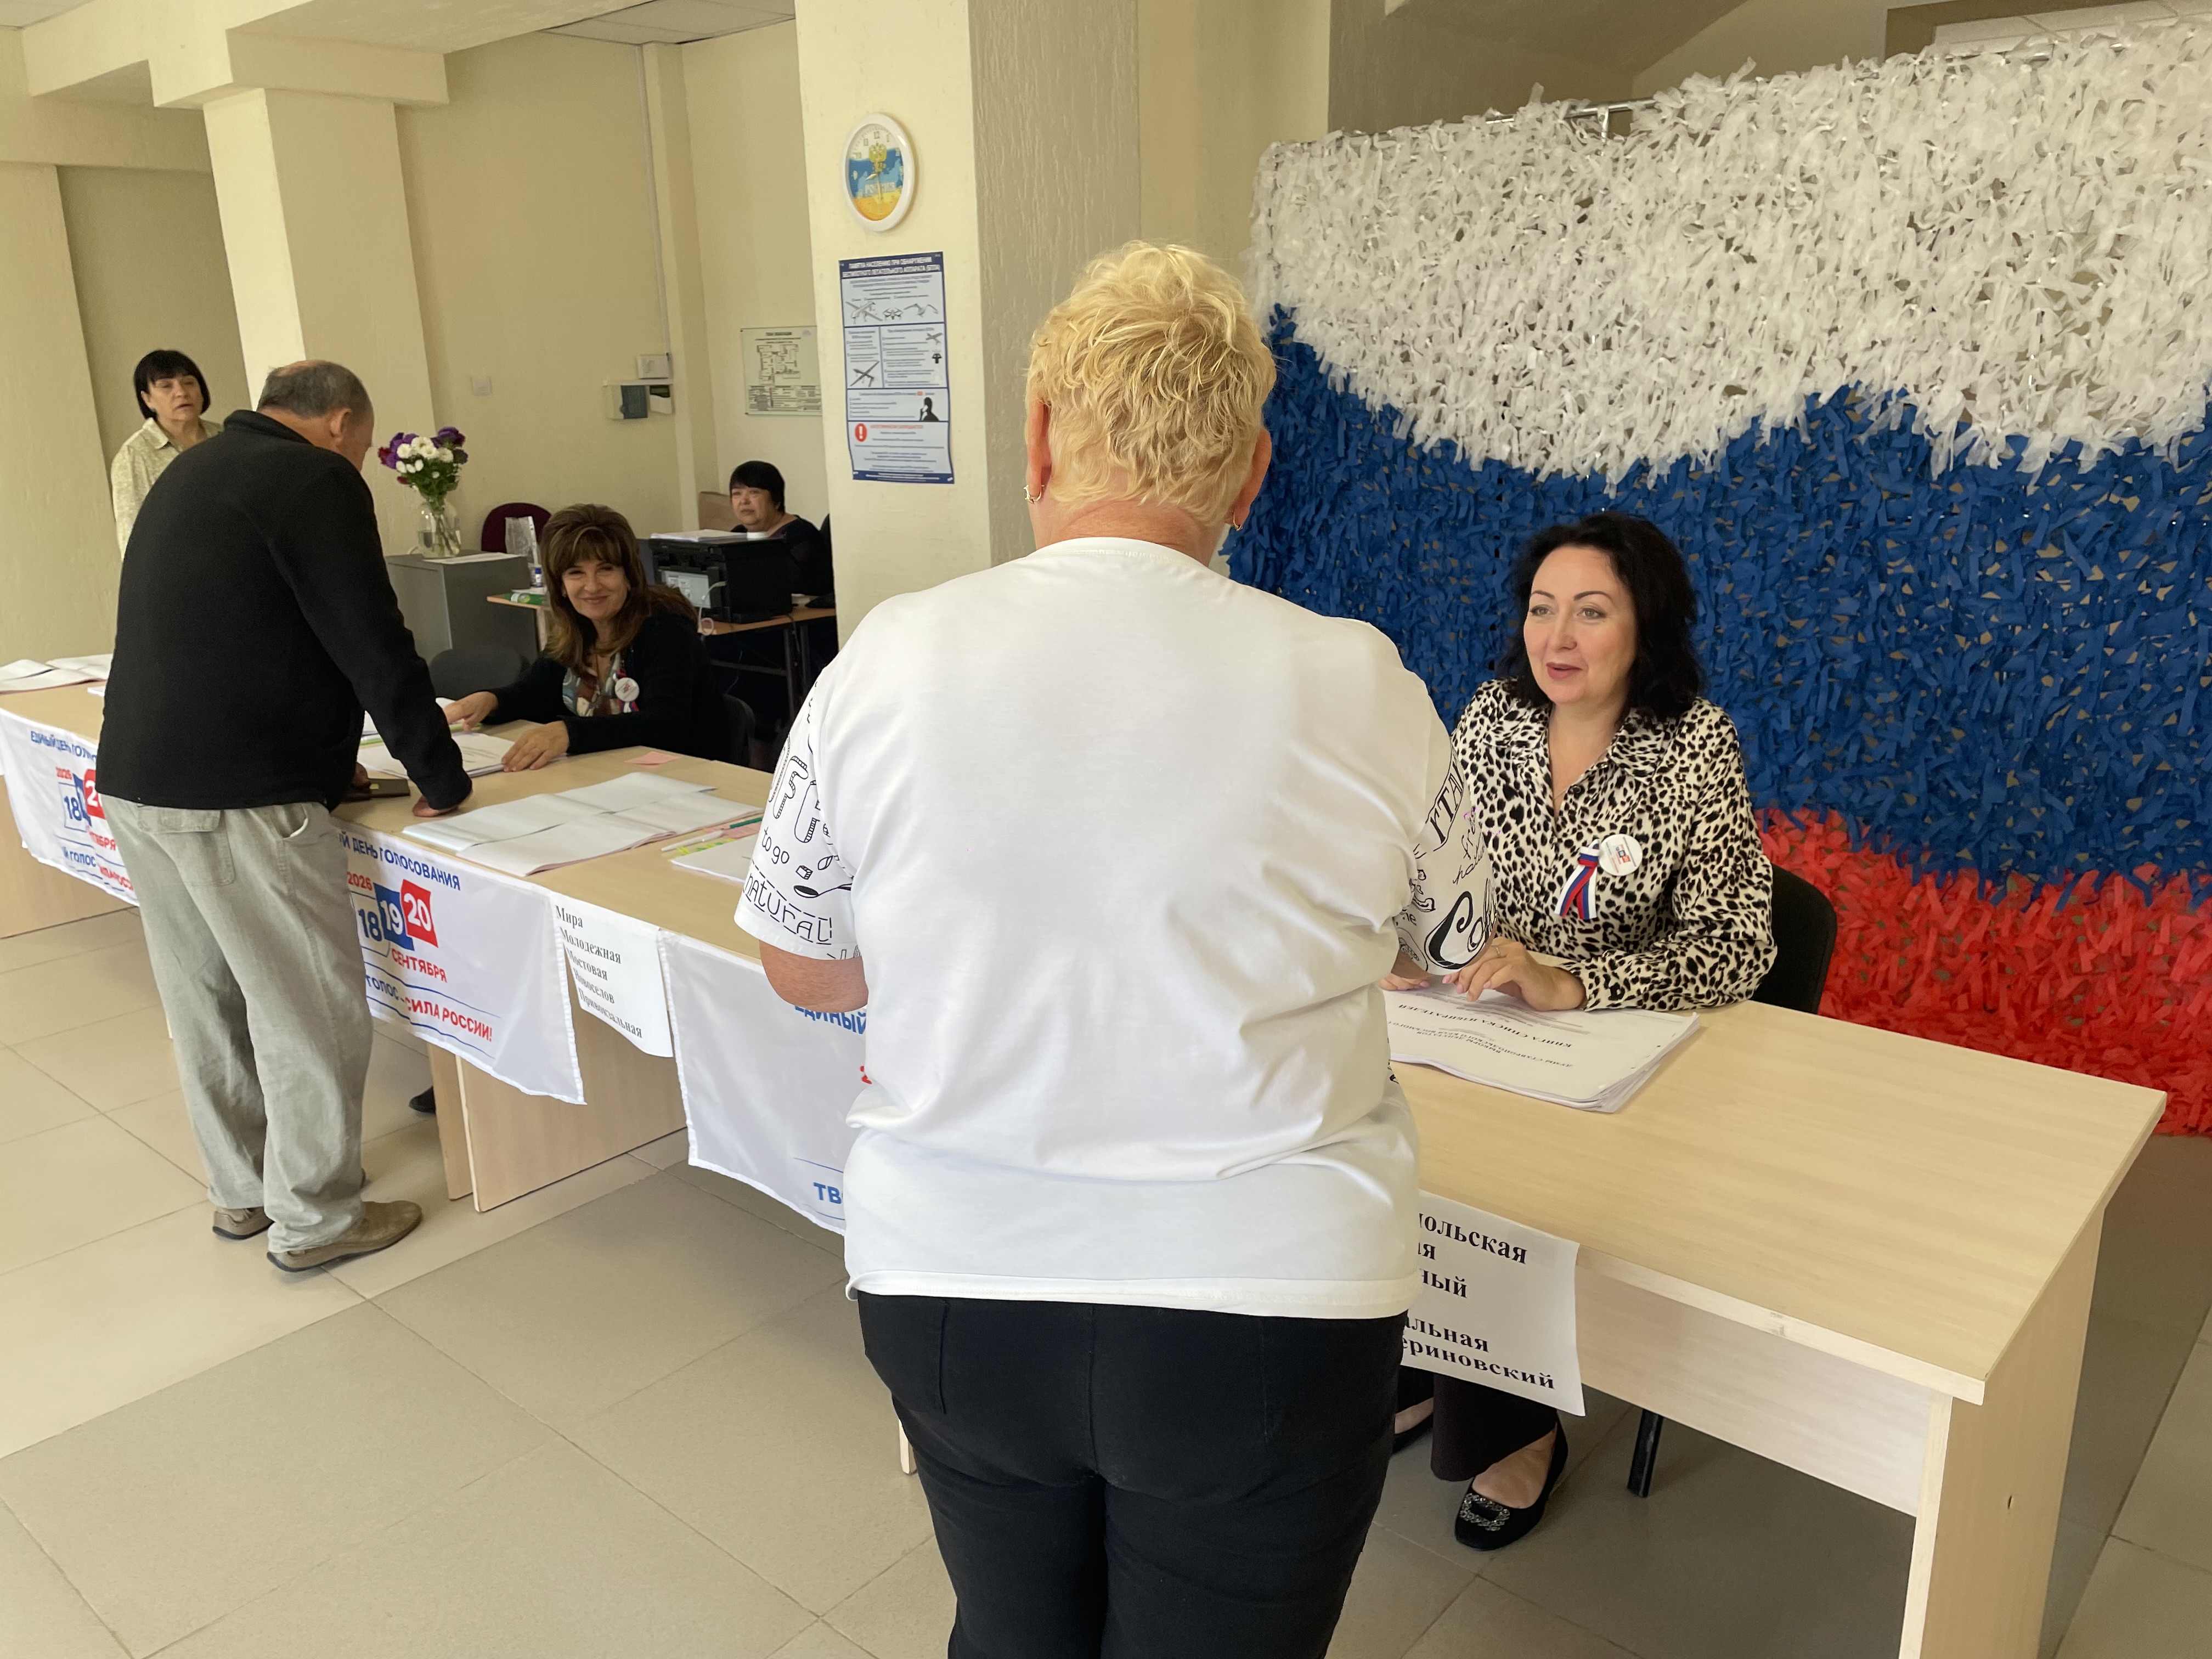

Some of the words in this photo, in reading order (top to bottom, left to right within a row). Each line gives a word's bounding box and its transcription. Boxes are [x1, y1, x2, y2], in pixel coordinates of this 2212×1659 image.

[352, 837, 379, 860] ДЕНЬ
[379, 847, 461, 891] ГОЛОСОВАНИЯ
[771, 845, 789, 865] go
[346, 871, 373, 892] 2026
[358, 907, 383, 943] 18
[380, 899, 404, 936] 19
[403, 893, 432, 932] 20
[555, 905, 583, 929] Мира
[560, 927, 622, 964] Молодежная
[391, 948, 448, 983] СЕНТЯБРЯ
[442, 1007, 493, 1042] РОССИИ!
[578, 987, 642, 1039] Привокзальная
[1407, 1318, 1489, 1353] льная
